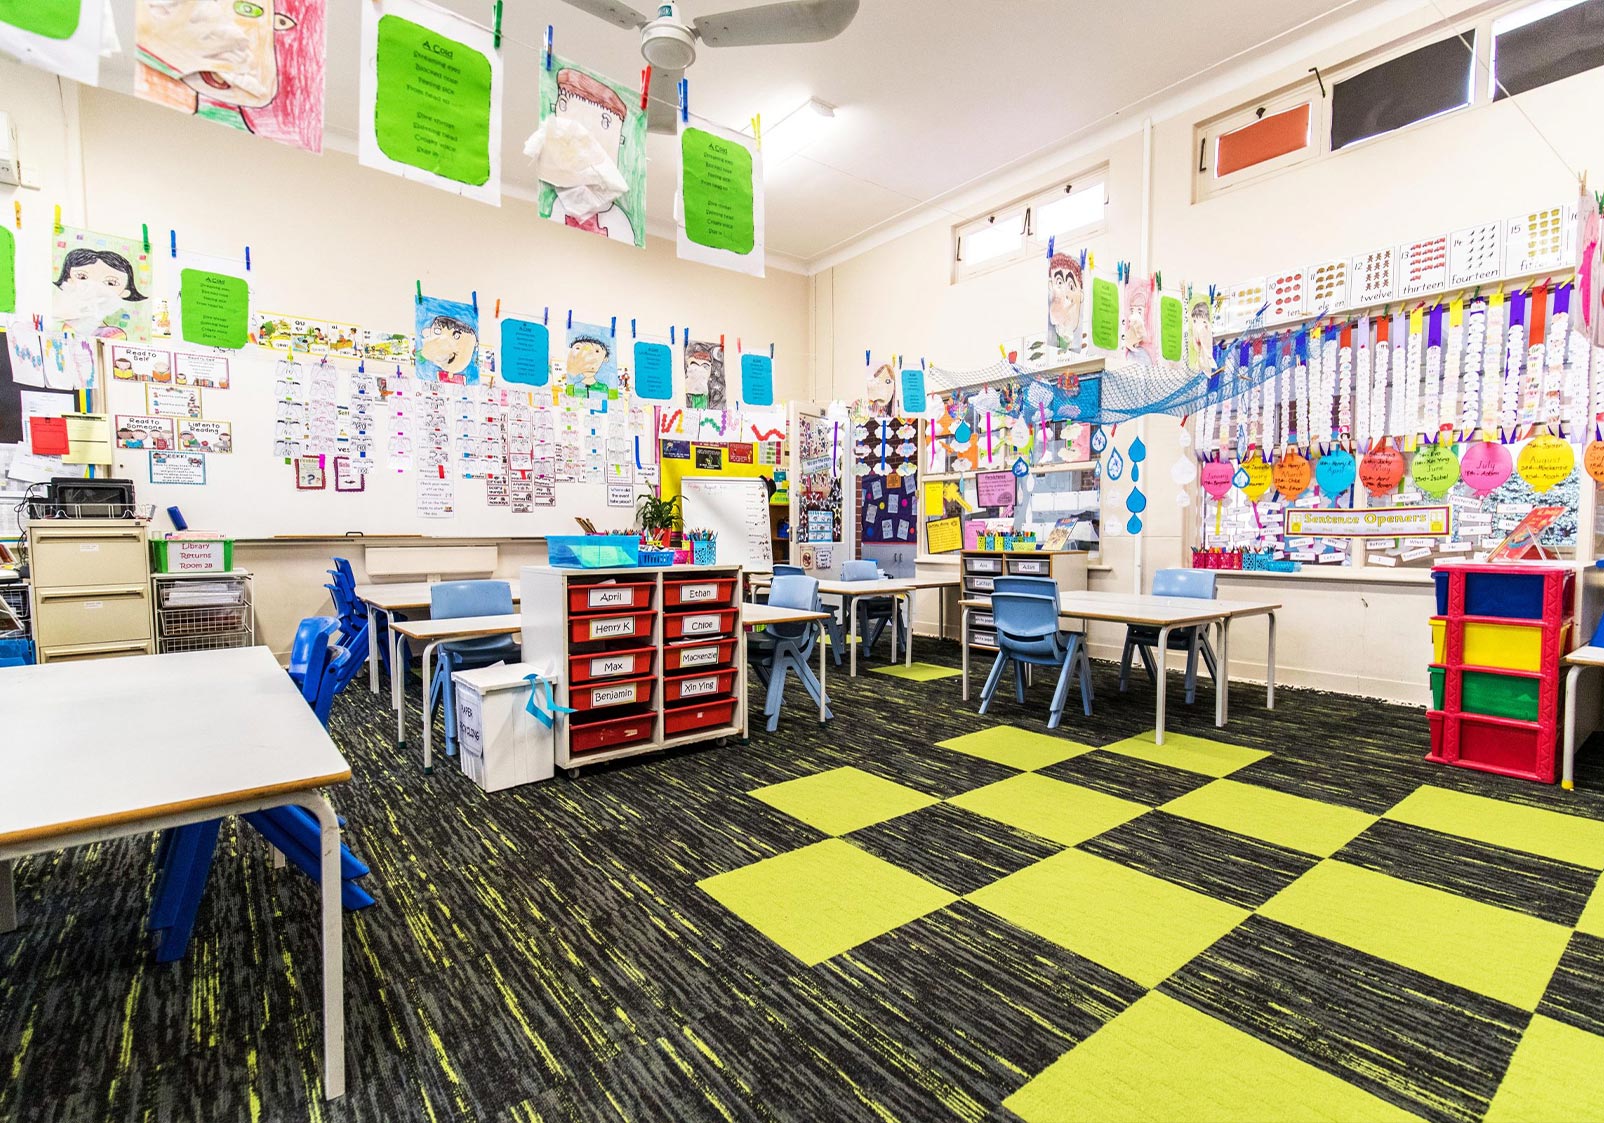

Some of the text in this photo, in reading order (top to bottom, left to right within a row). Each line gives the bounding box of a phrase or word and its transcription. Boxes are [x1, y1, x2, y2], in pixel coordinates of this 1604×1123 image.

[1510, 224, 1521, 234] 15
[1401, 251, 1409, 259] 13
[1354, 262, 1363, 270] 12
[1451, 268, 1498, 285] fourteen
[1403, 280, 1444, 295] thirteen
[1360, 290, 1392, 302] twelve
[1318, 300, 1345, 311] eleen
[1530, 456, 1560, 464] August
[1476, 461, 1495, 470] July
[1304, 513, 1426, 527] Sentence Openers
[600, 592, 622, 601] April
[689, 589, 711, 599] Ethan
[596, 622, 630, 633] Henry K
[692, 621, 713, 630] Chloe
[682, 652, 717, 662] Mackenzie
[604, 662, 623, 672] Max
[685, 682, 714, 693] Xin Ying
[595, 689, 632, 702] Benjamin
